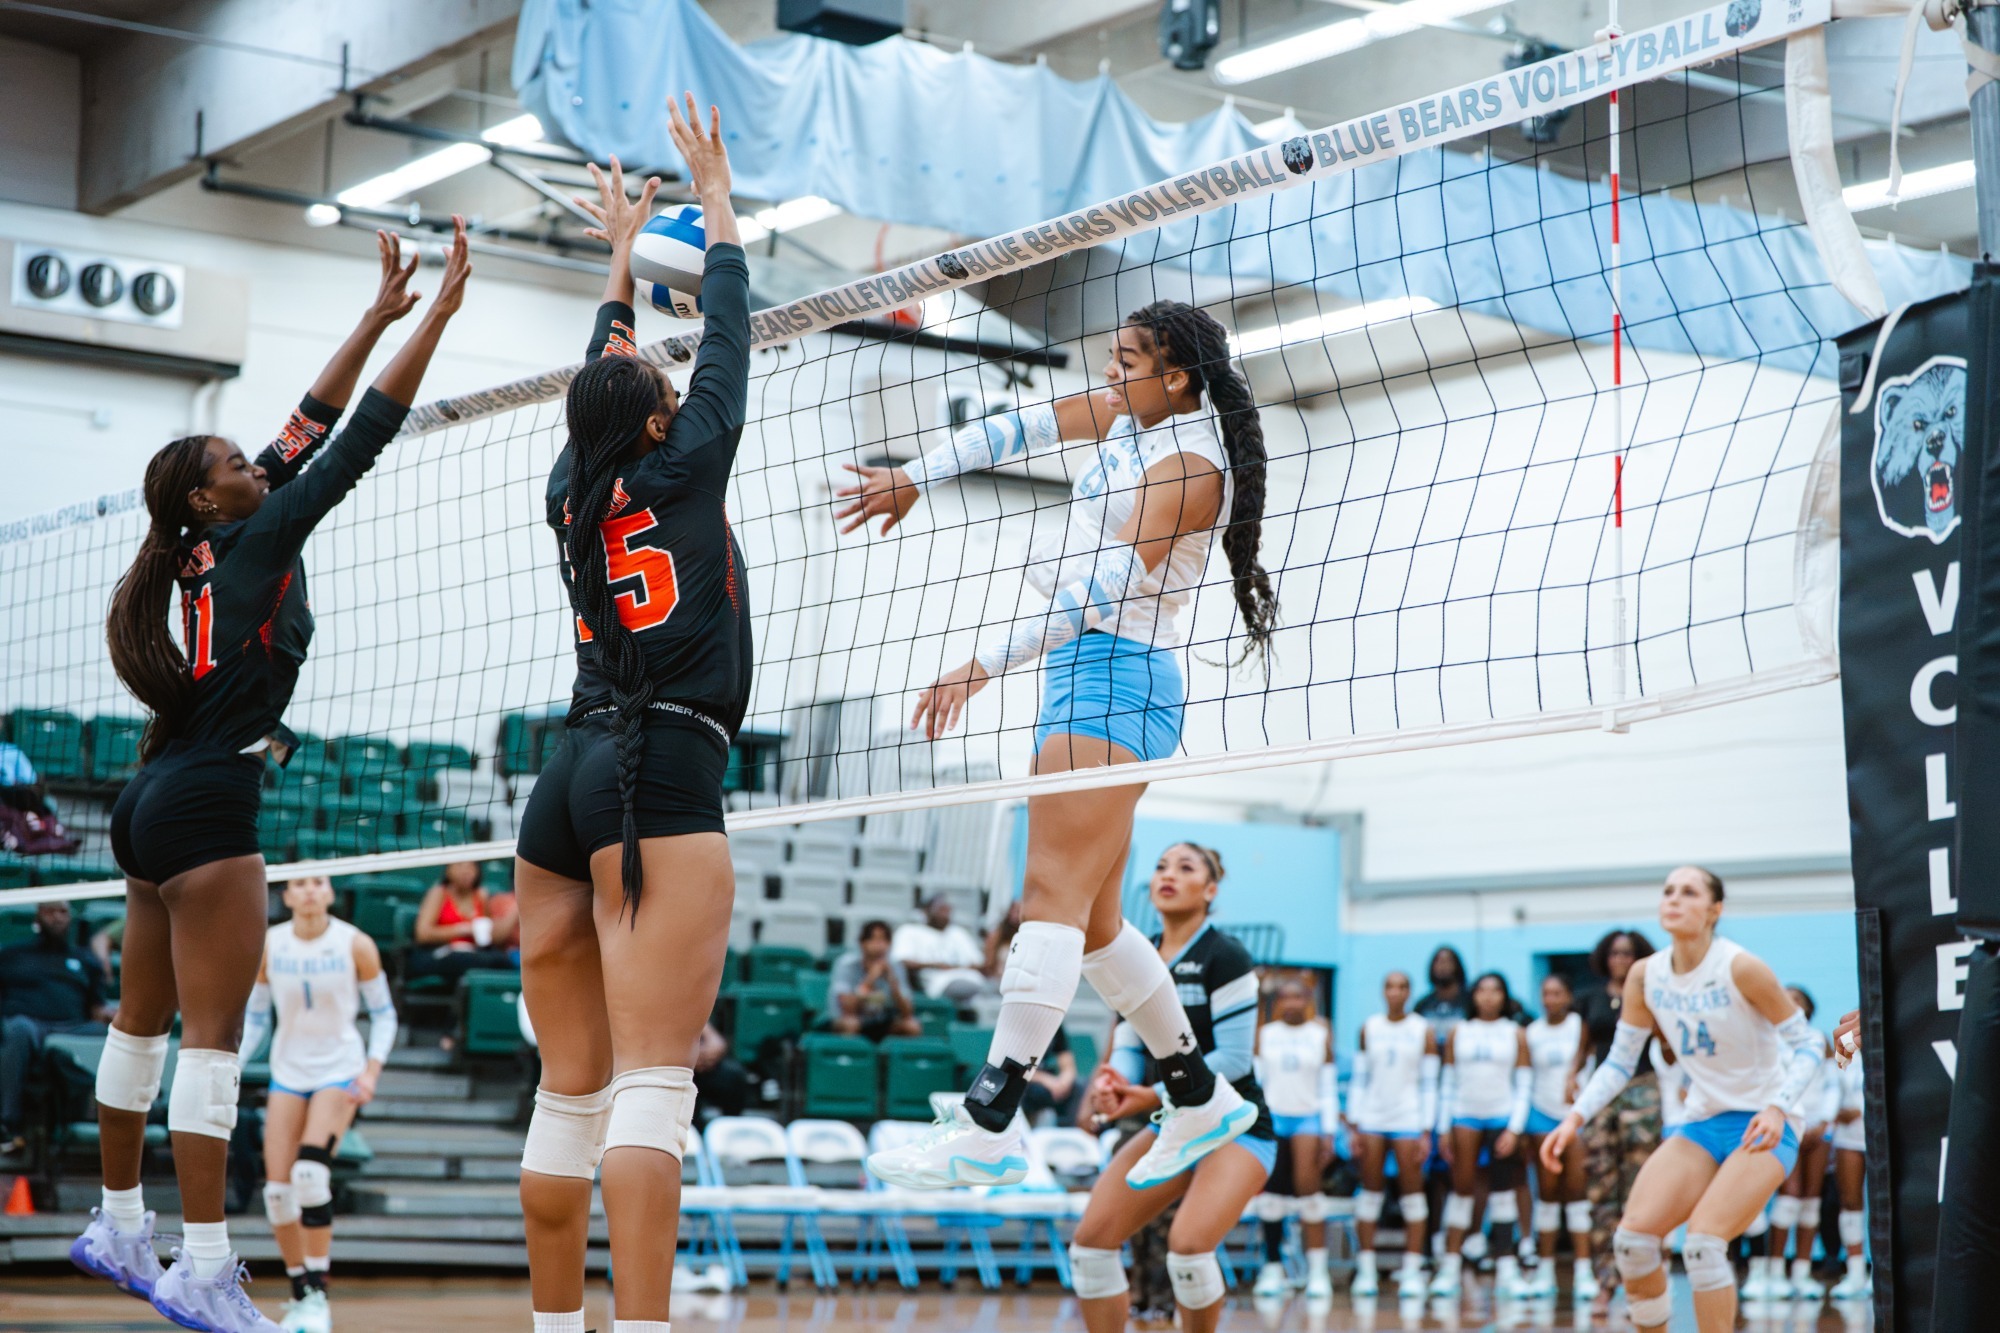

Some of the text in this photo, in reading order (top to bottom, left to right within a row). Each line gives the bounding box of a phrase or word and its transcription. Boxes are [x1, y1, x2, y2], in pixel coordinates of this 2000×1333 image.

[1312, 13, 1720, 168] BLUE BEARS VOLLEYBALL
[961, 150, 1286, 276] BLUE BEARS VOLLEYBALL
[803, 264, 949, 322] VOLLEYBALL
[453, 391, 495, 418] BLUE
[494, 376, 561, 405] BEARS
[564, 507, 680, 643] 5
[647, 701, 694, 717] UNDER
[1677, 1020, 1716, 1055] 24
